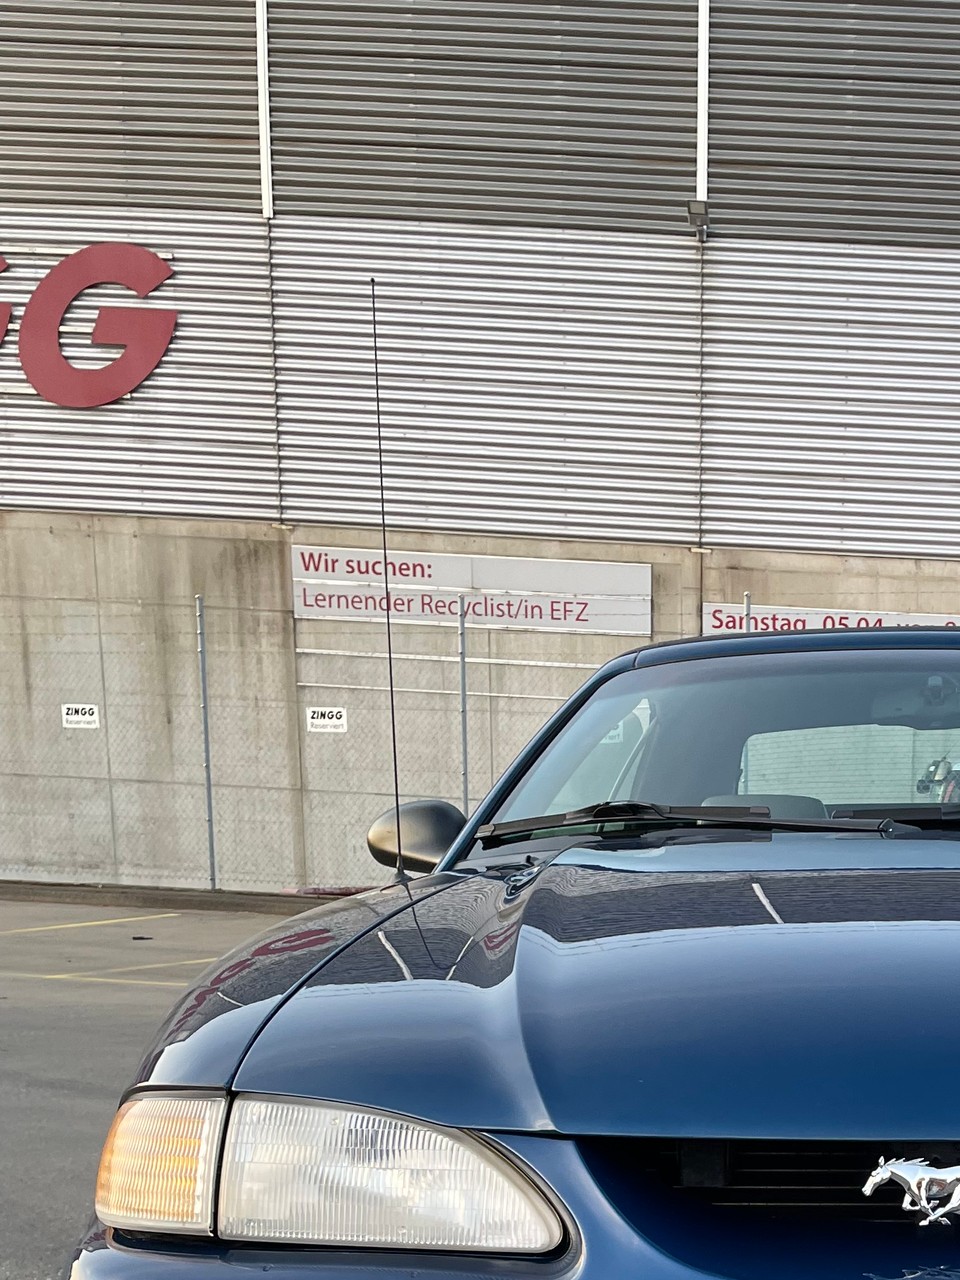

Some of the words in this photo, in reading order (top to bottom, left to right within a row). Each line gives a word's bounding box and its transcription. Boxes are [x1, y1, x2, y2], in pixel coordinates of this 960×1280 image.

[300, 552, 339, 573] Wir
[345, 559, 433, 579] suchen:
[302, 587, 414, 613] Lernender
[421, 594, 543, 620] Recyclist/in
[550, 601, 589, 622] EFZ
[822, 615, 883, 628] 0504
[65, 707, 95, 716] ZINGG
[310, 710, 343, 720] ZINGG
